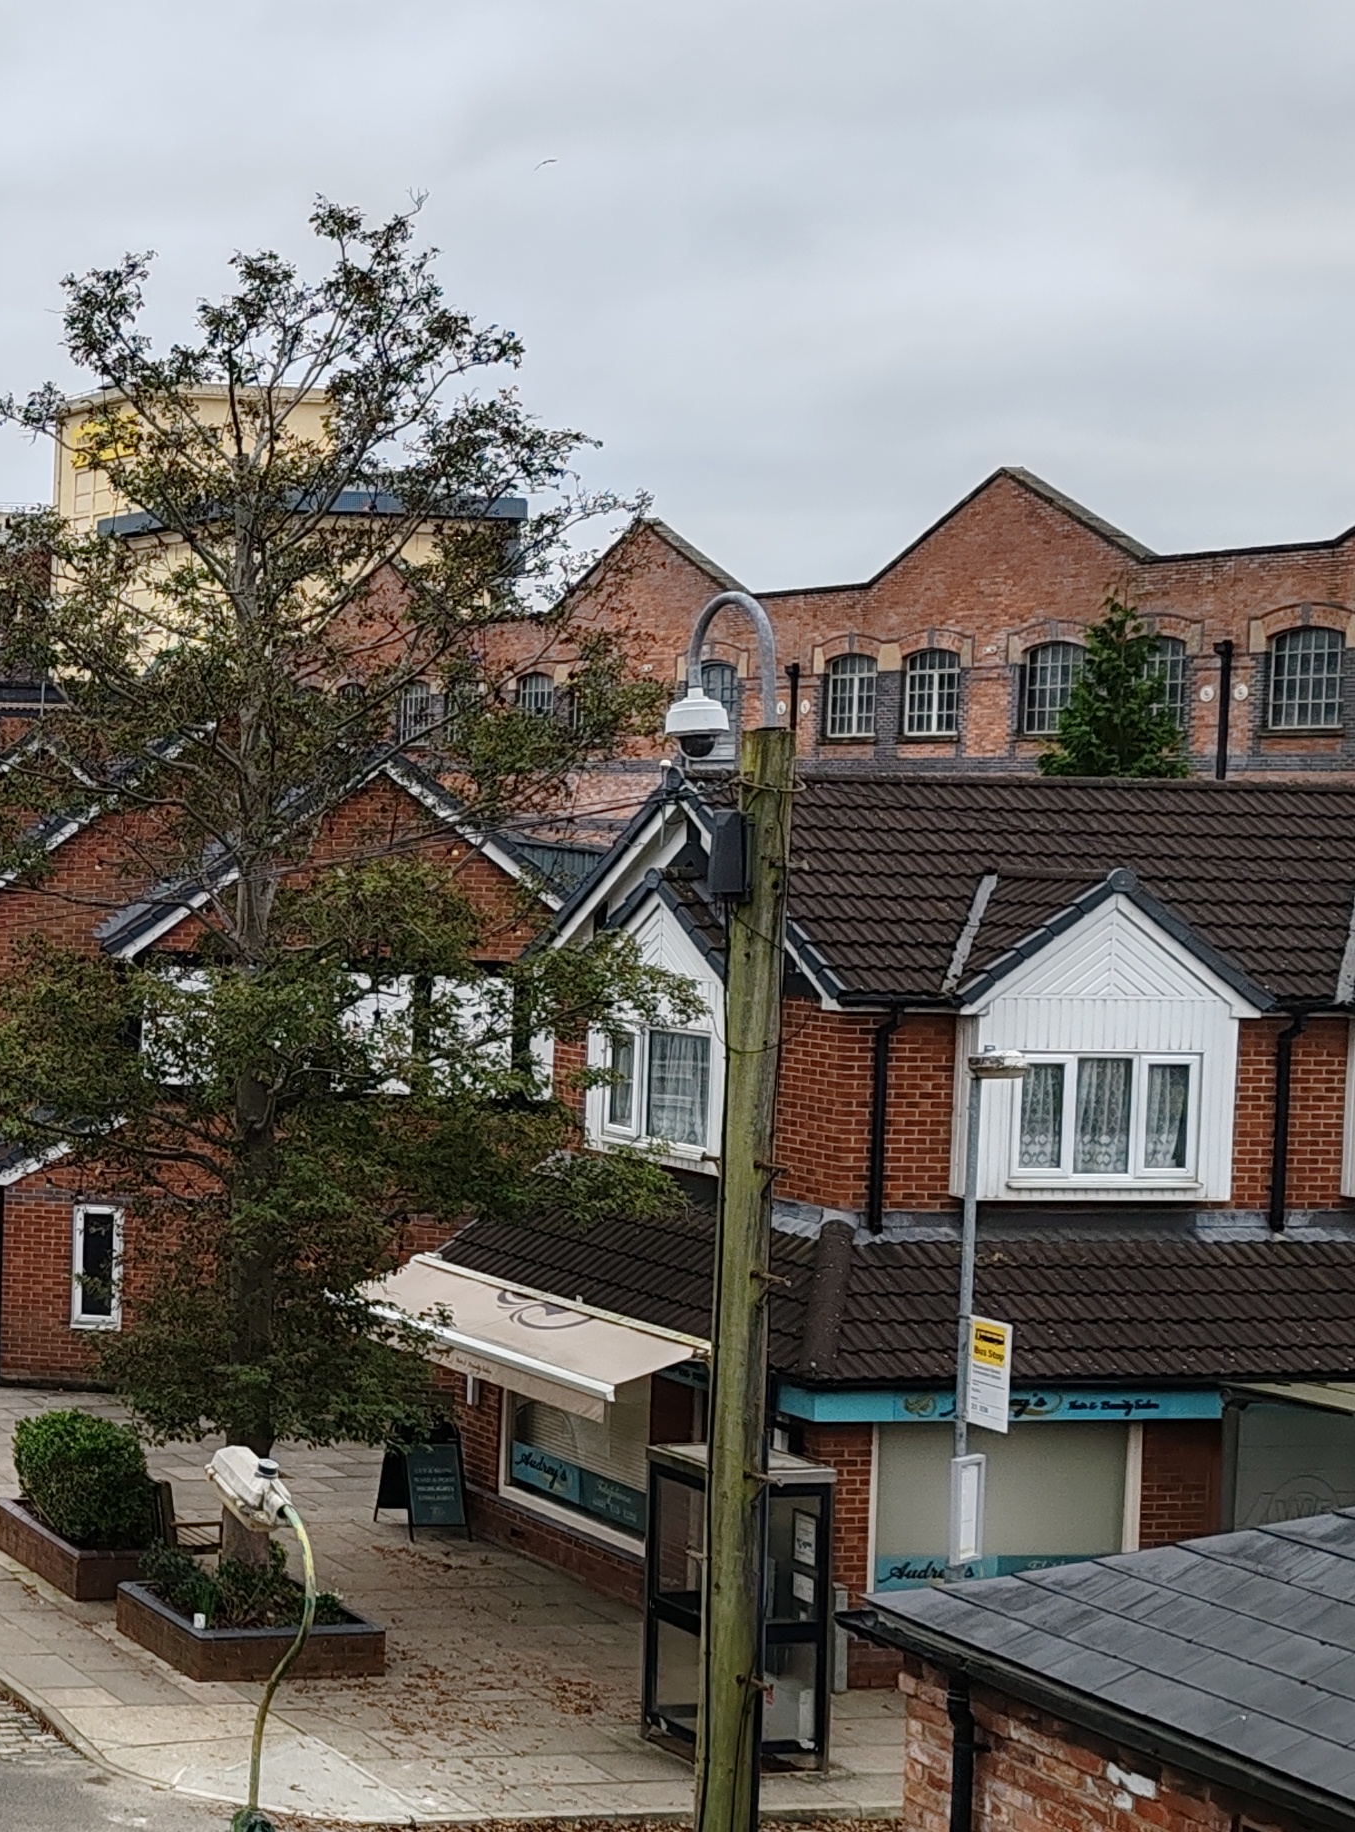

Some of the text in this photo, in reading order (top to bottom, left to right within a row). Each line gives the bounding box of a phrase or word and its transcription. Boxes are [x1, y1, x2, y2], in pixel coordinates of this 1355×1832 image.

[974, 1345, 1005, 1362] Bus Stop
[515, 1452, 567, 1489] Audrey's
